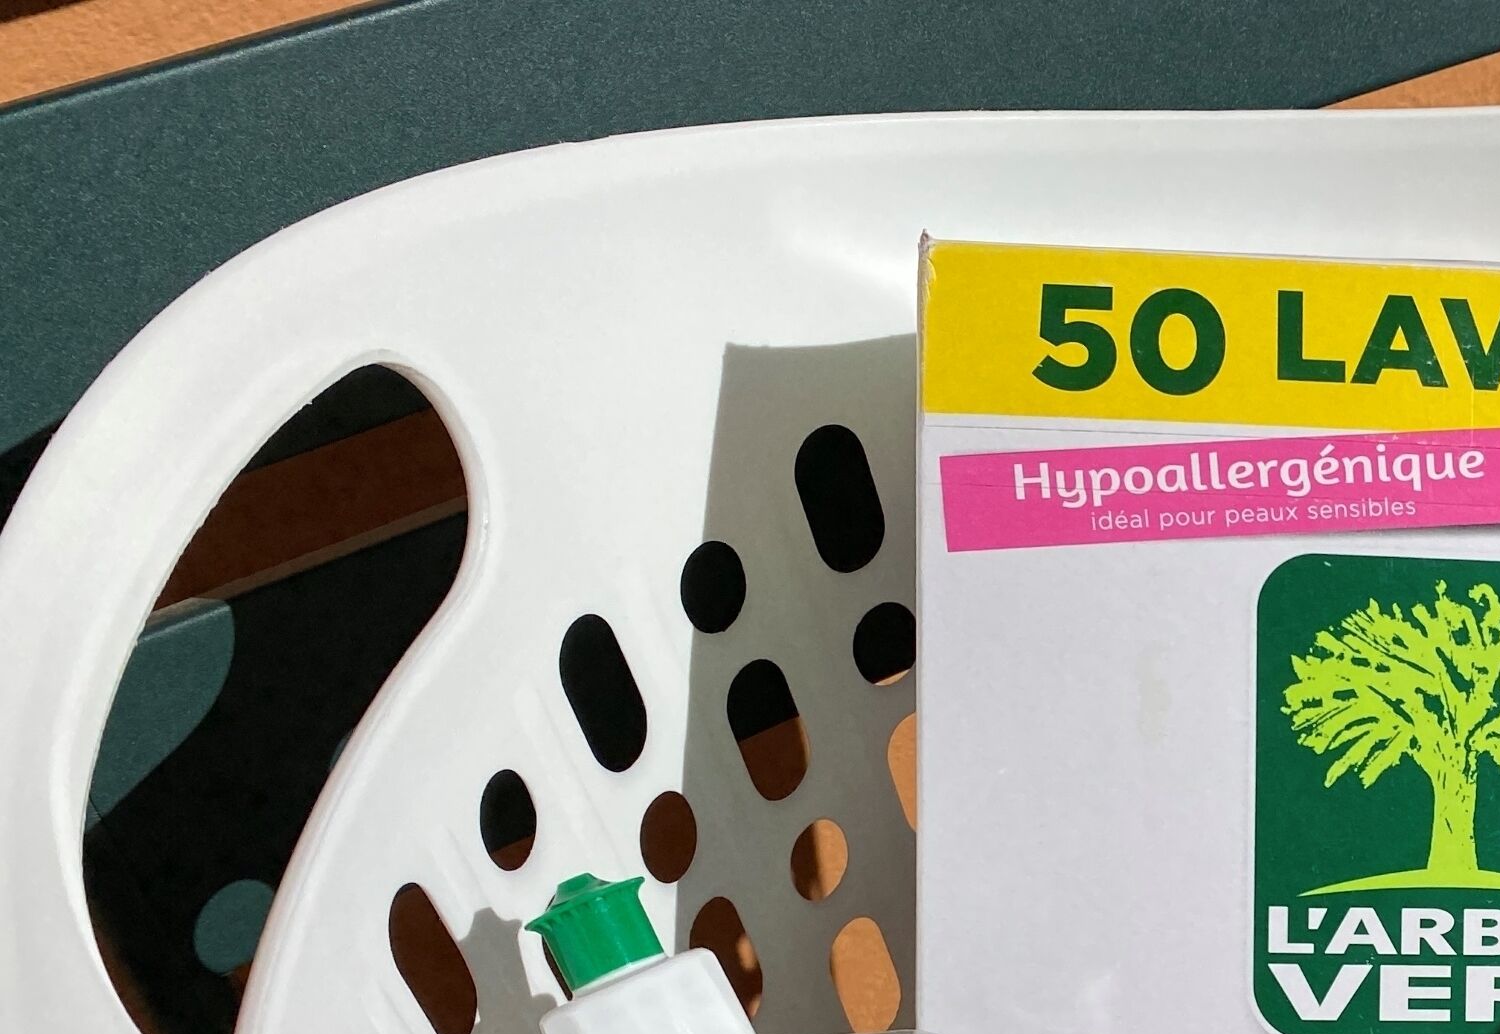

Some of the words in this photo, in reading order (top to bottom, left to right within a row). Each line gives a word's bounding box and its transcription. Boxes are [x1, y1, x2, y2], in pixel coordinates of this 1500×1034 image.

[1031, 283, 1226, 396] 50
[1014, 445, 1485, 508] Hypoallergénique
[1091, 510, 1150, 531] idéal
[1160, 510, 1215, 530] pour
[1225, 506, 1298, 528] peaux
[1306, 497, 1416, 520] sensibles
